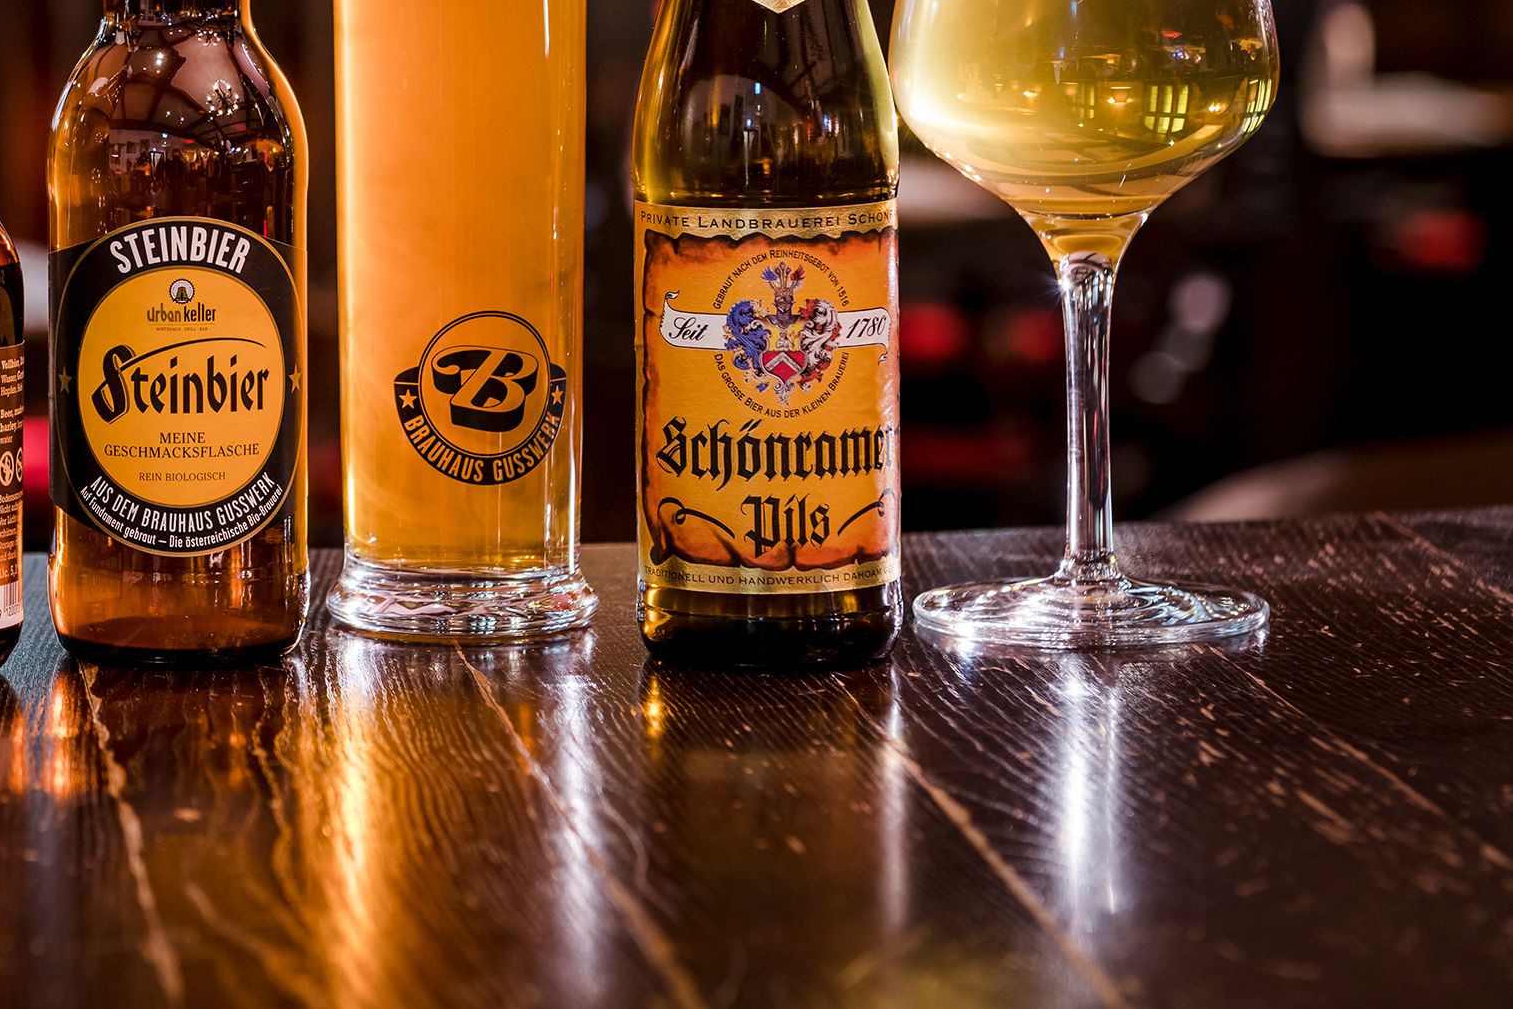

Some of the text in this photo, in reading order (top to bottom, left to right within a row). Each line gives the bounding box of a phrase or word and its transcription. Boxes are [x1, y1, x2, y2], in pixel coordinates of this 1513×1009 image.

[640, 211, 690, 227] PRIVATE
[698, 216, 840, 229] LANDBRAUEREI
[110, 226, 250, 274] STEINBIER
[712, 249, 850, 309] GEBRAUT NACH DEM REINHEITSGEBOT VON 1516
[146, 302, 216, 323] urban keller
[668, 317, 708, 341] Seit
[92, 341, 270, 424] Steinbier
[714, 351, 850, 418] DAS GROSSE BIER AUS DER KLEINEN BRAUEREI
[104, 443, 260, 459] GESCHMACKSFLASCHE
[160, 433, 206, 444] MEINE
[404, 413, 560, 483] BRAUHAUS GUSSWERK
[139, 471, 226, 481] REIN BIOLOGISCH
[80, 486, 92, 501] Auf
[89, 497, 124, 532] Fundament
[123, 526, 156, 545] gebraut
[169, 535, 183, 548] Die
[186, 519, 248, 548] österreichische
[246, 483, 283, 527] Bio-Brauerei
[90, 471, 275, 533] AUS DEM BRAUHAUS GUSSWERK
[740, 493, 830, 559] Pils
[645, 565, 705, 583] TRADITIONELL
[708, 575, 734, 585] UND
[739, 574, 840, 585] HANDWERKLICH
